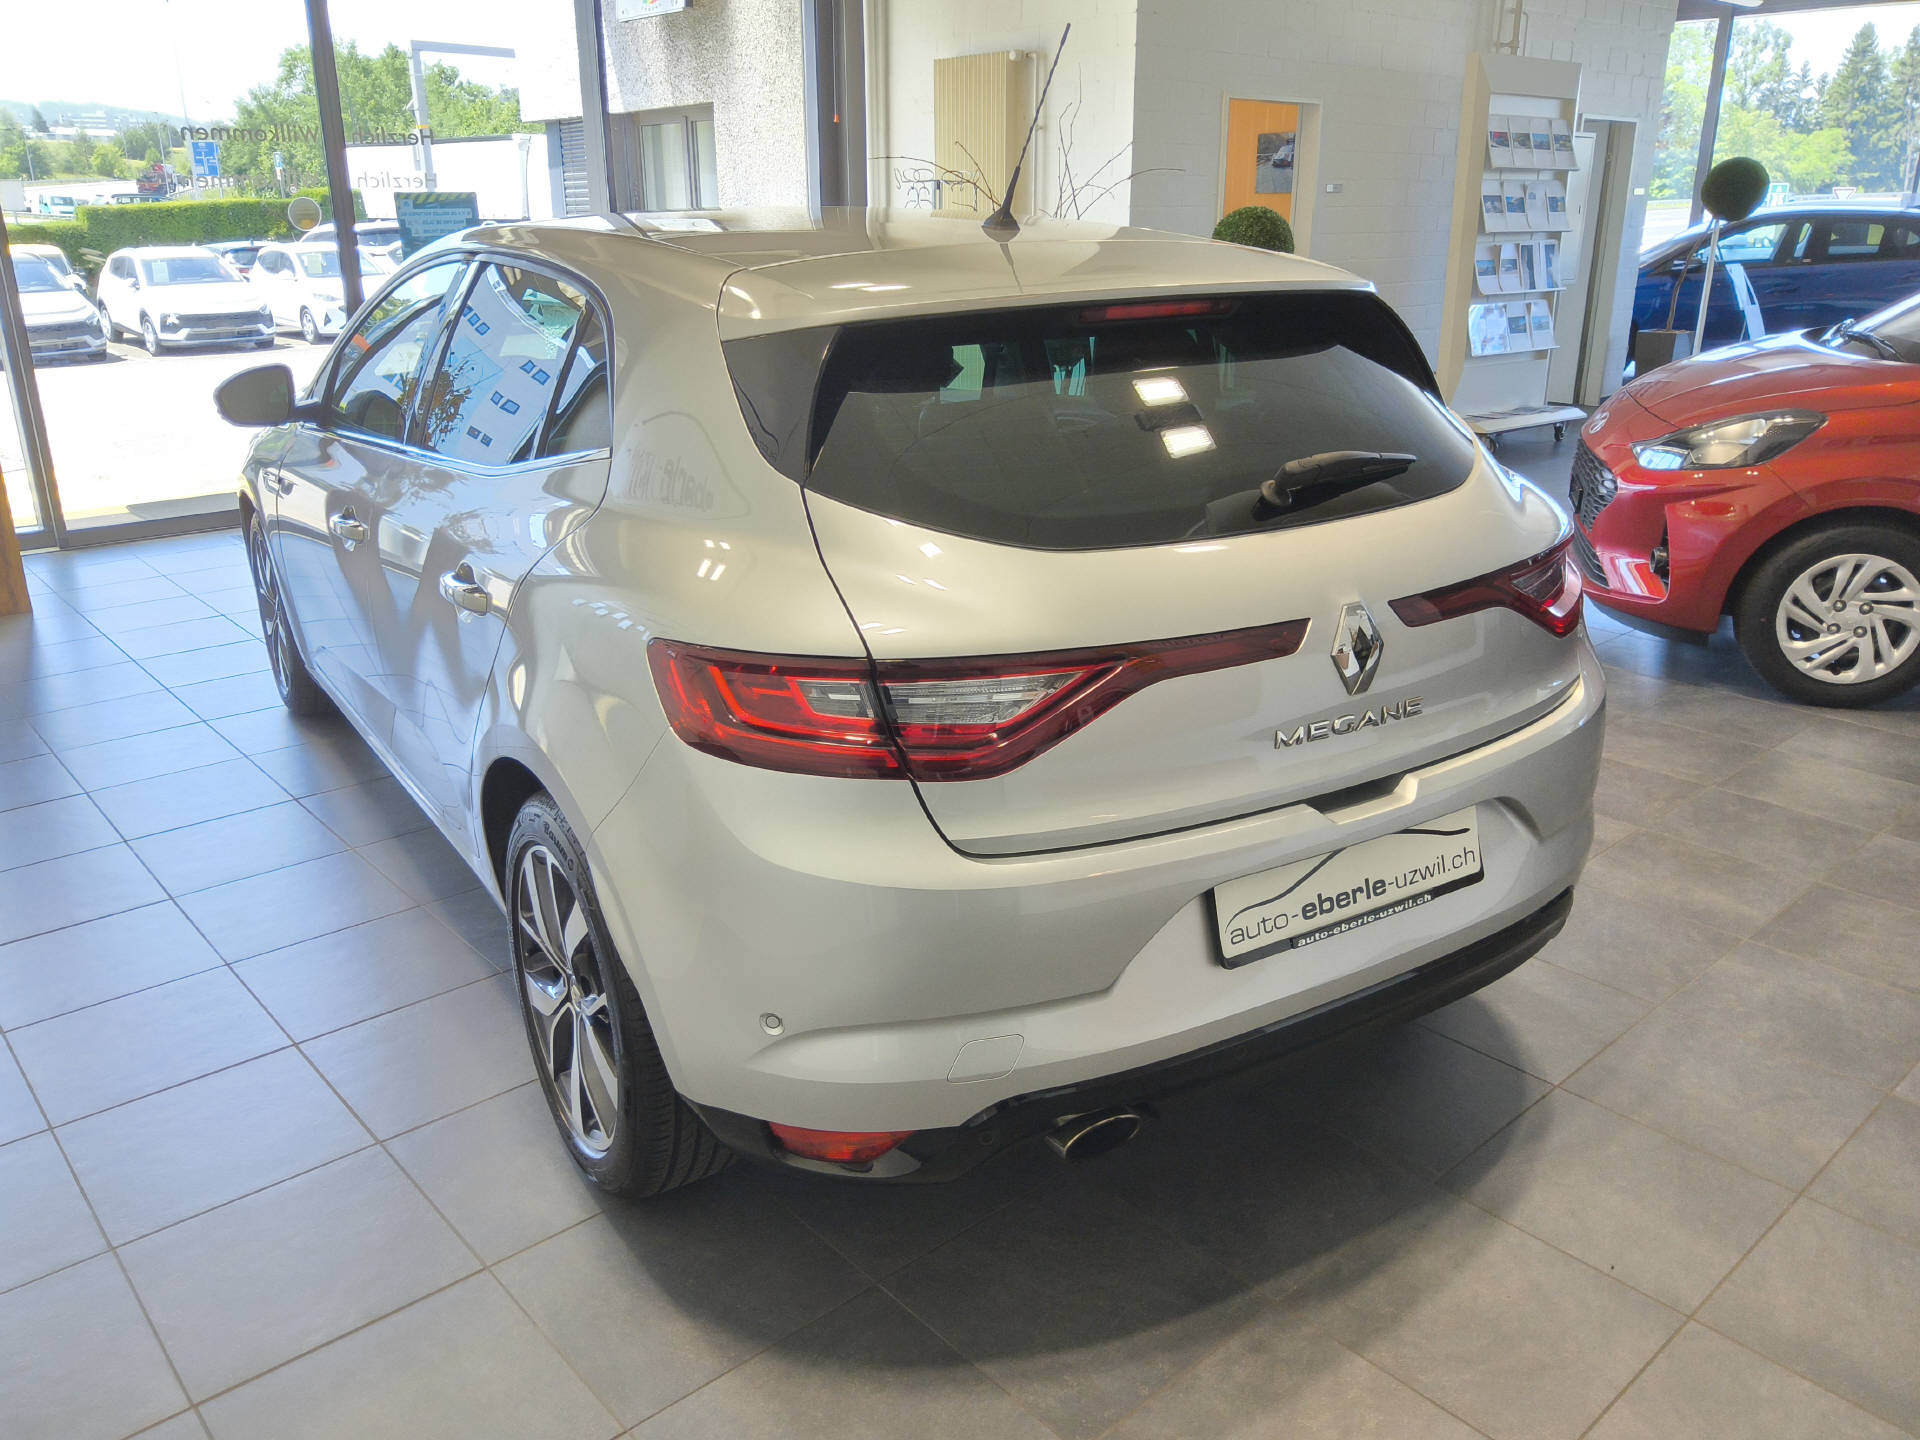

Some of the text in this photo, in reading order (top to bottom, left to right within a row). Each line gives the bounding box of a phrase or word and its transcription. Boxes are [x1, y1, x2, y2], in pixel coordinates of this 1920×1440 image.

[1274, 697, 1424, 750] MEGANE
[1230, 846, 1477, 945] auto-eberle-uzwil.ch
[1297, 894, 1432, 947] auto-eberle-uzwil.ch
